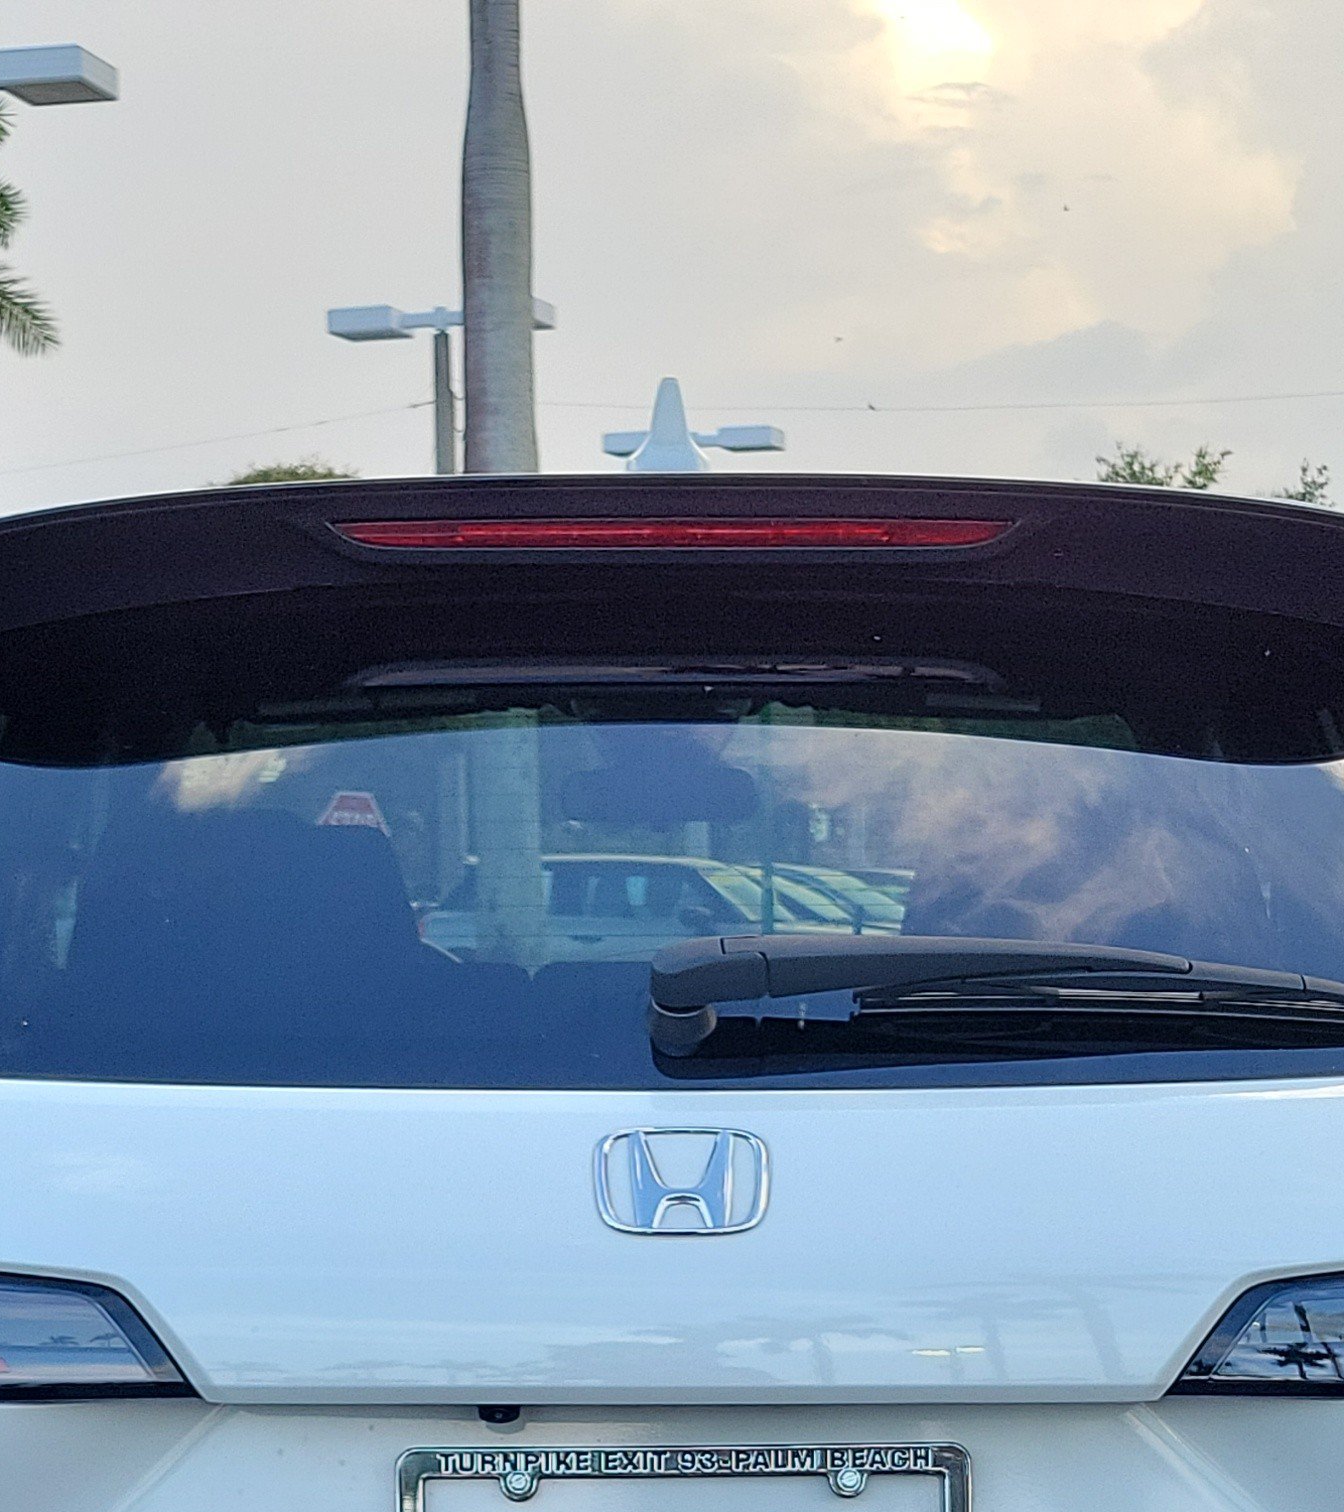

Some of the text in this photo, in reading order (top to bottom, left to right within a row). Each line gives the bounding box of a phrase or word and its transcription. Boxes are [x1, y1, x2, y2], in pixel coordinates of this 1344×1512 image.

[436, 1452, 592, 1474] TURNPIKE
[601, 1450, 669, 1473] EXIT
[826, 1446, 934, 1471] BEACH
